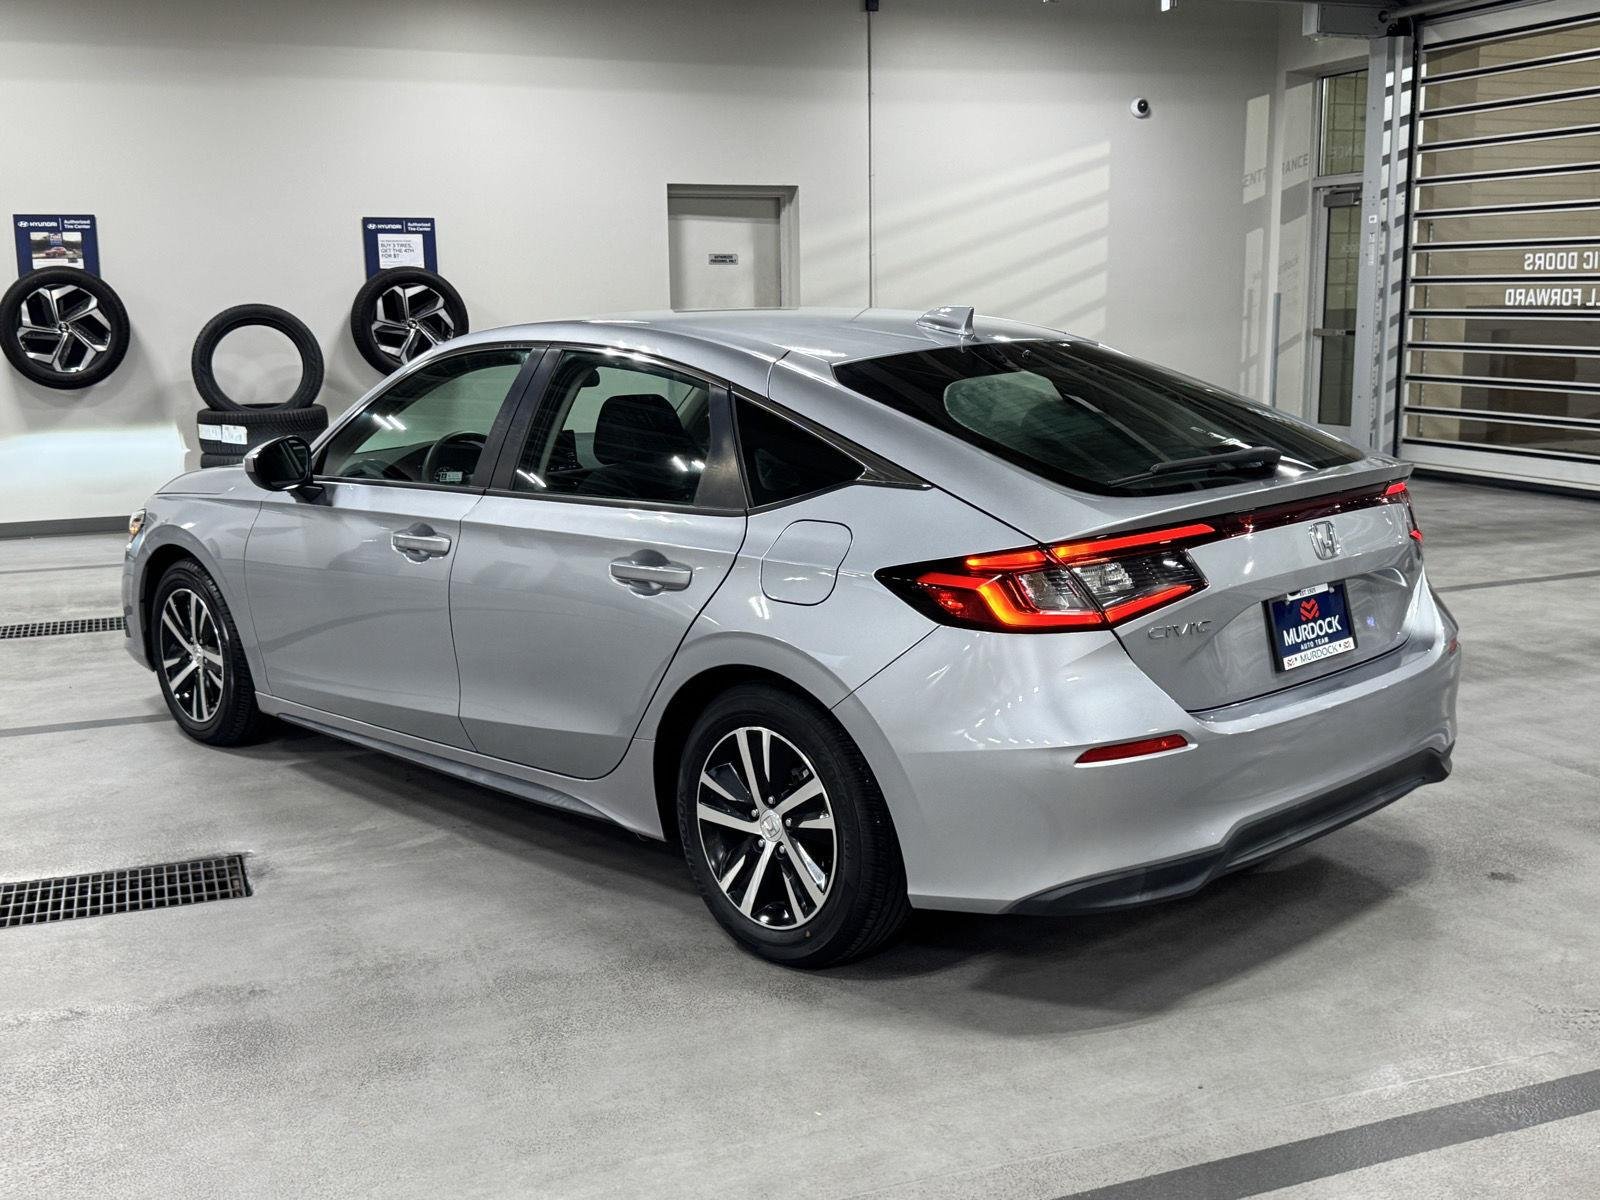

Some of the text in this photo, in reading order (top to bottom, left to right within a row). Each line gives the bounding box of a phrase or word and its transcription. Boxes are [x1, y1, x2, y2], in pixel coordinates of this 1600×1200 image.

[1147, 620, 1212, 640] CIVIC
[1282, 614, 1342, 647] MURDOCK
[1300, 636, 1329, 650] AUTO TEAM
[1300, 643, 1339, 663] MURDOCK
